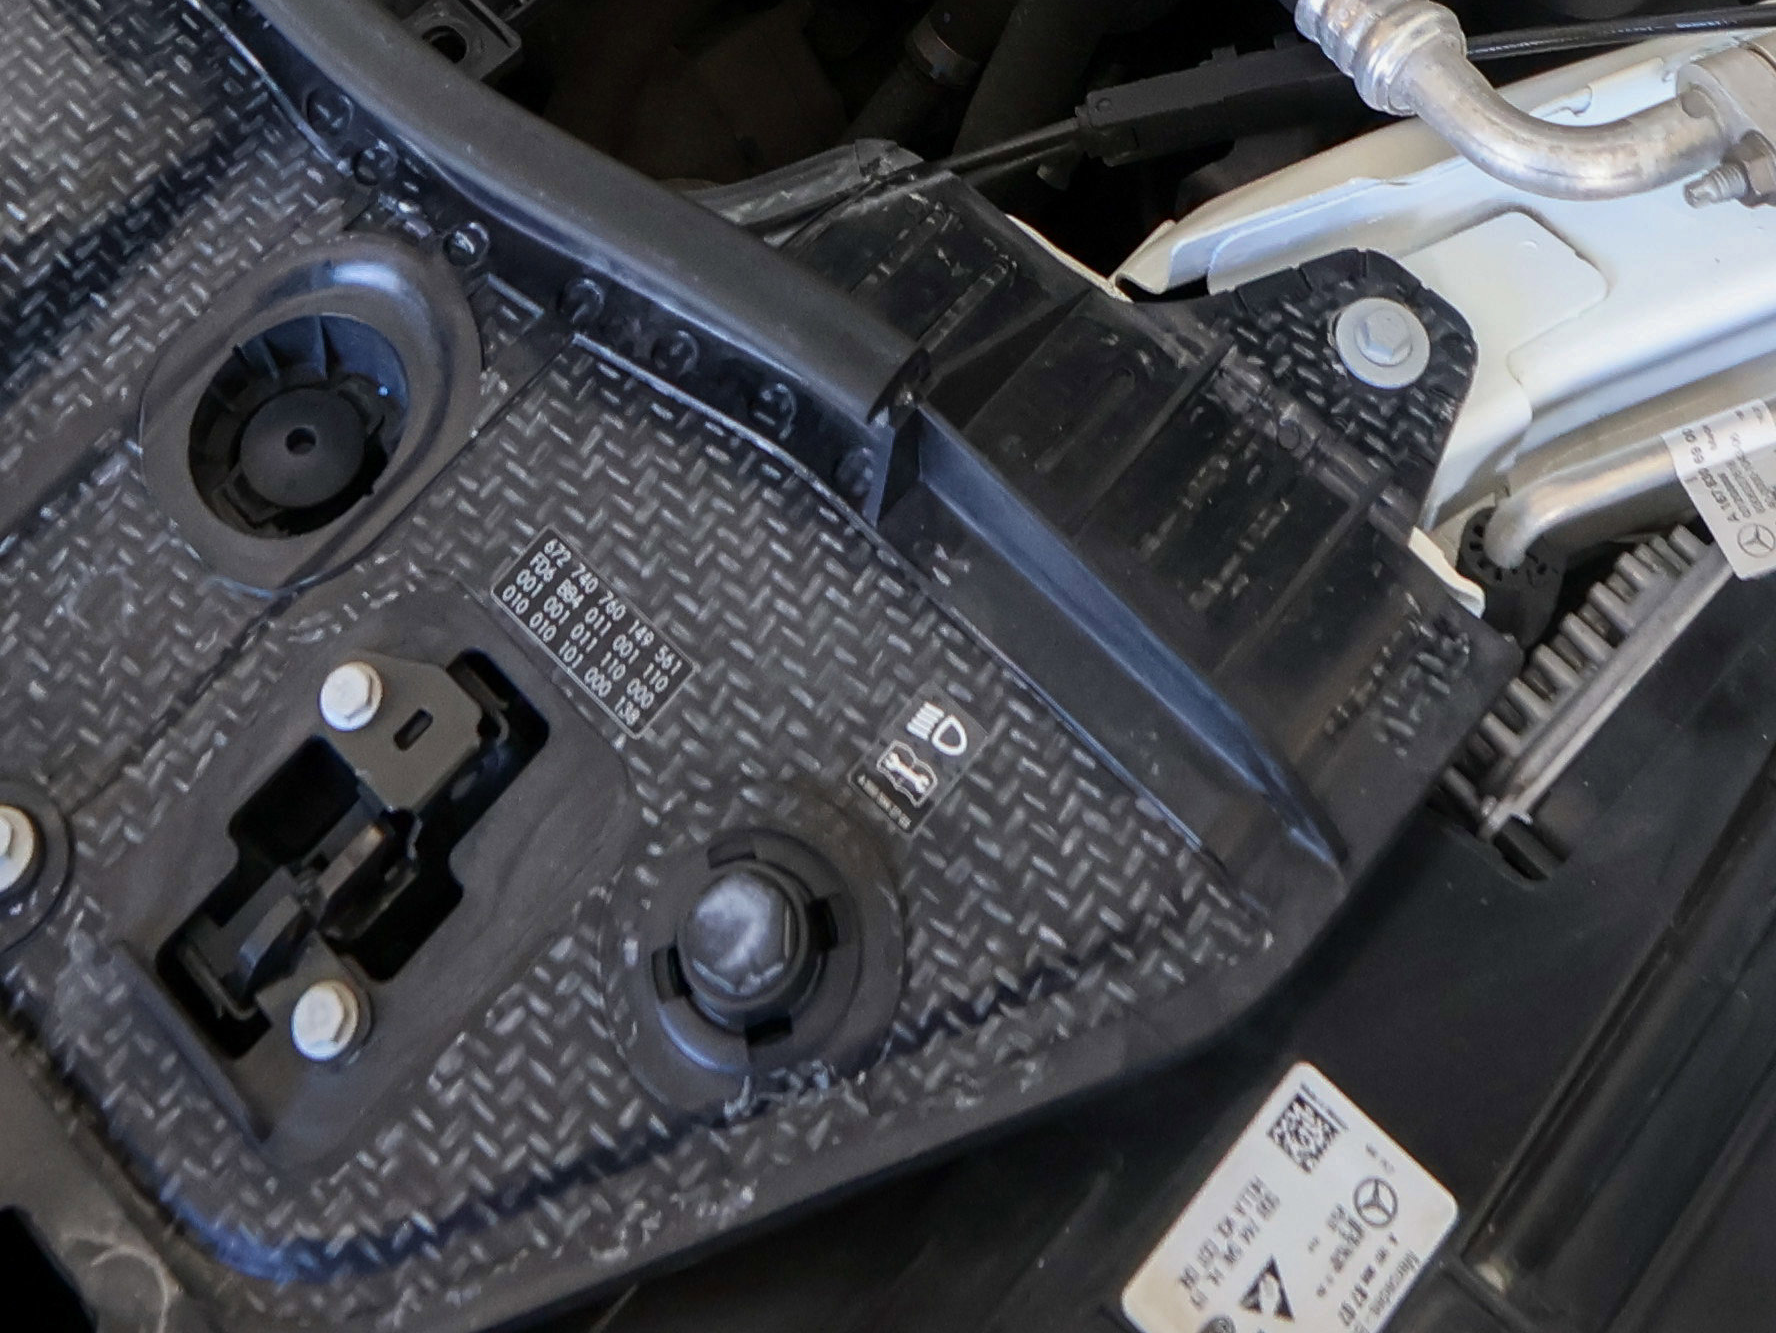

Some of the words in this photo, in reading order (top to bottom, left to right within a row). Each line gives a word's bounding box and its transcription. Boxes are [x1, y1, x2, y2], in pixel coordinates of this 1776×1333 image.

[502, 585, 529, 615] 010
[529, 612, 557, 642] 010
[558, 640, 584, 668] 101
[584, 667, 612, 697] 000
[516, 569, 544, 598] 001
[544, 596, 570, 625] 001
[570, 622, 598, 653] 011
[601, 651, 626, 680] 110
[627, 678, 654, 709] 000
[530, 551, 557, 582] FD6
[585, 607, 612, 637] 011
[613, 634, 640, 664] 001
[642, 663, 668, 693] 110
[544, 538, 571, 567] 672
[571, 563, 598, 594] 740
[598, 590, 626, 621] 760
[628, 619, 654, 646] 149
[655, 645, 683, 676] 561
